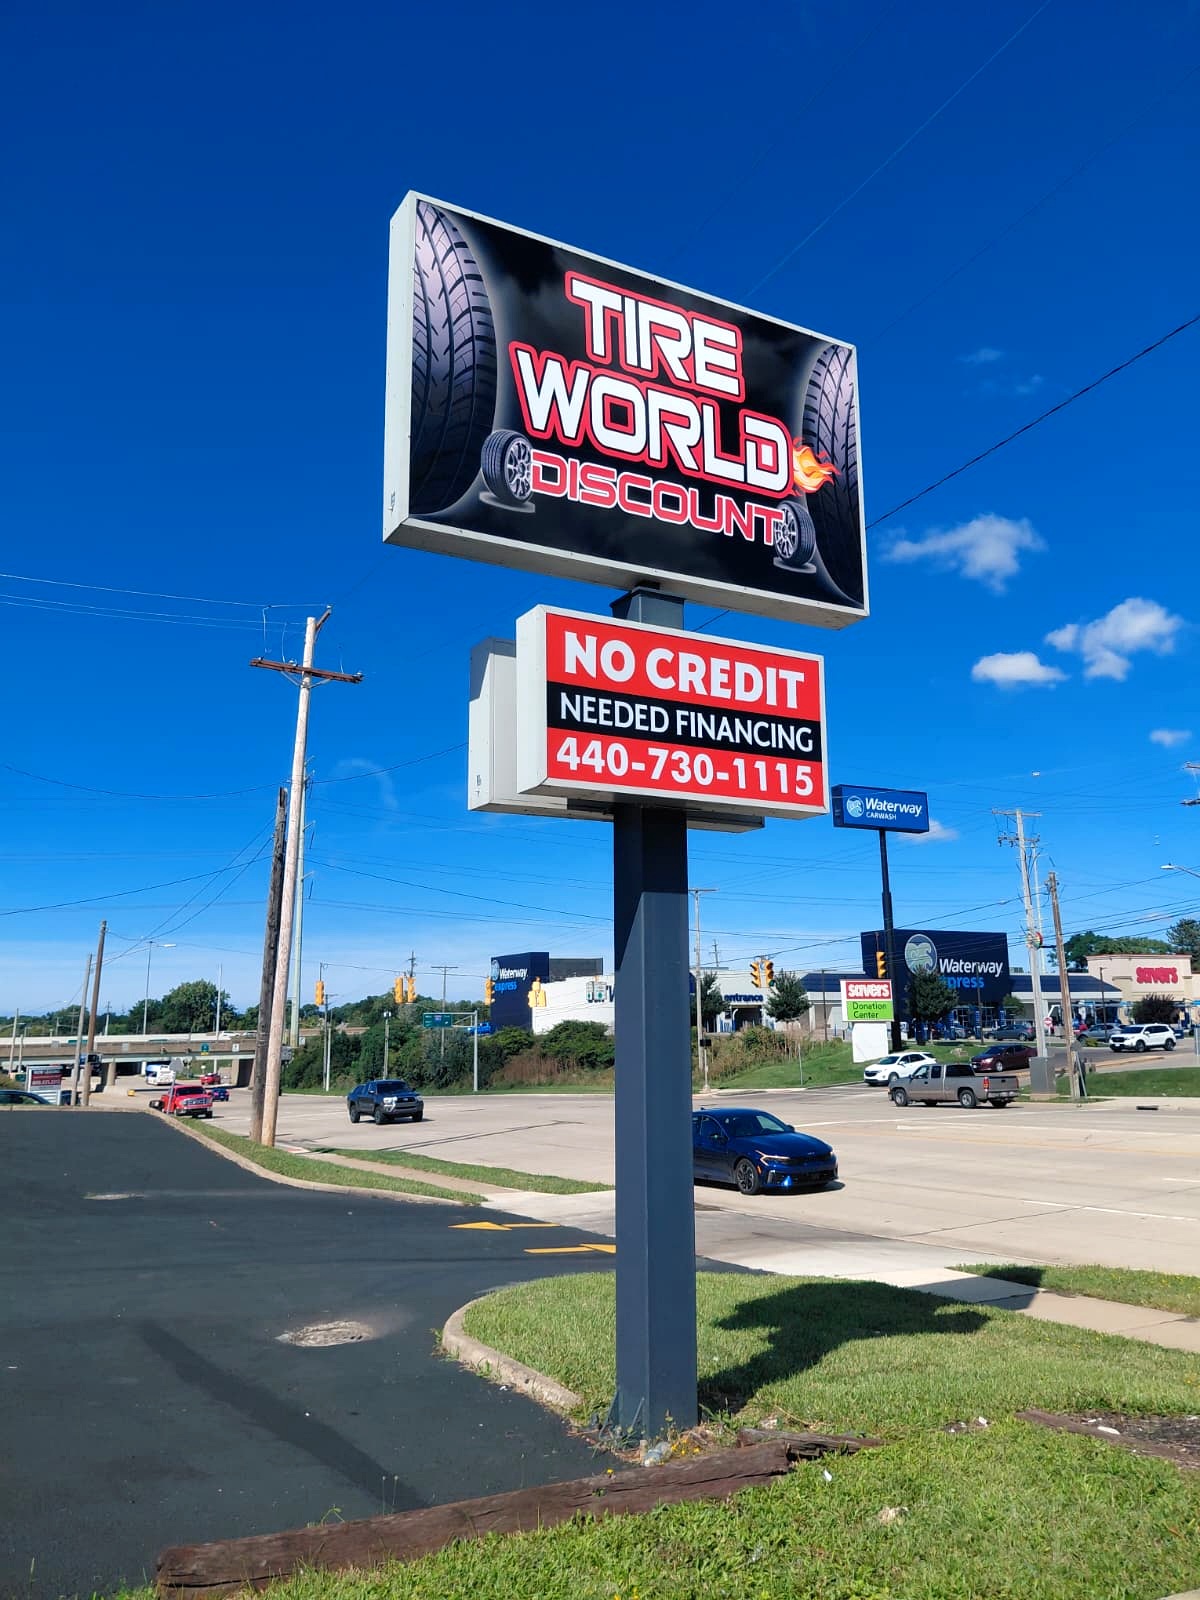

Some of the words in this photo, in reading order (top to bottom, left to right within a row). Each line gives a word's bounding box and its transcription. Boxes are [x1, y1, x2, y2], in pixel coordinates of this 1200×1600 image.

[566, 272, 744, 399] TIRE
[510, 342, 793, 497] WORLD
[530, 451, 784, 546] DISCOUNT
[564, 631, 636, 683] NO
[646, 648, 805, 709] CREDIT
[560, 692, 669, 733] NEEDED
[676, 709, 813, 752] FINANCING
[556, 737, 814, 797] 440-730-1115
[865, 797, 922, 817] Waterway
[866, 811, 896, 820] CARWASH
[500, 968, 528, 980] Waterway
[939, 958, 1003, 977] Waterway
[724, 993, 763, 1002] entrance
[852, 1001, 887, 1010] Donation
[853, 1010, 879, 1019] Center
